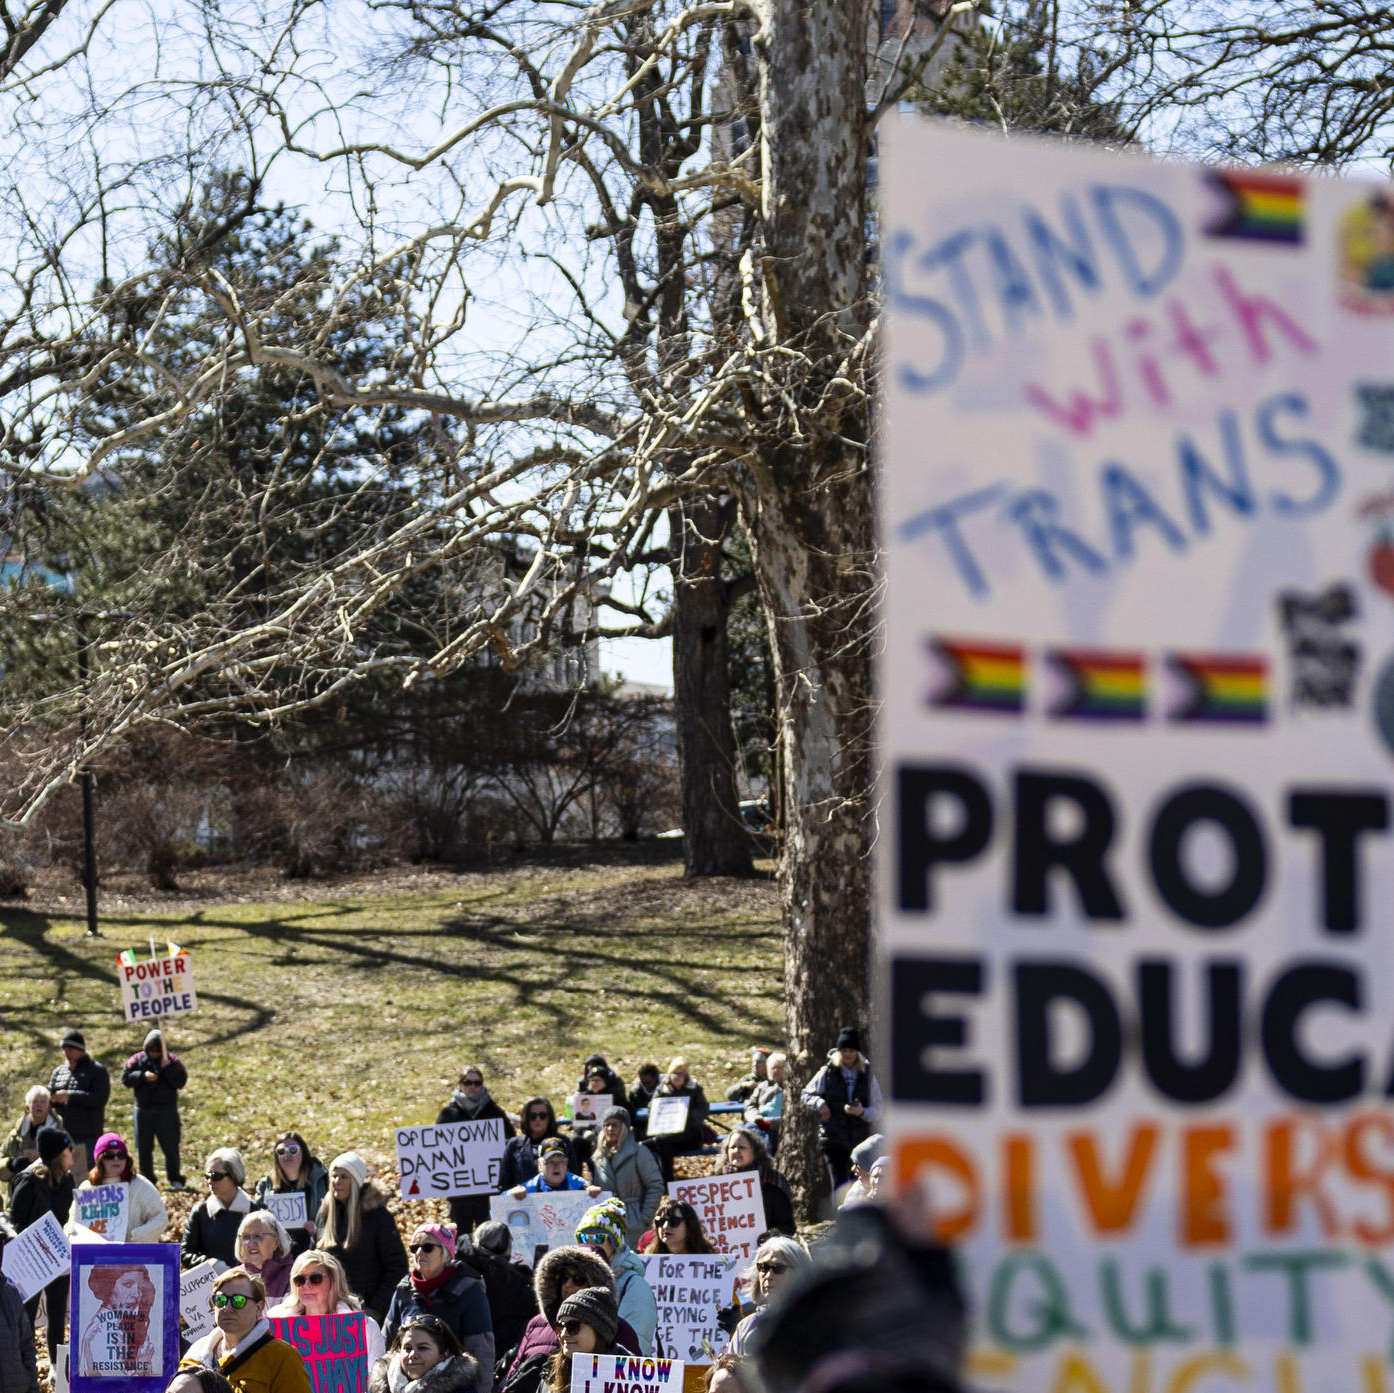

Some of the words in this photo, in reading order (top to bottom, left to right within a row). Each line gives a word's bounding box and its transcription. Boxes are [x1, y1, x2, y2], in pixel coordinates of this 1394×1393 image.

[886, 183, 1187, 396] STAND
[895, 393, 1342, 603] TRANS
[124, 958, 186, 982] POWER
[131, 981, 152, 999] TO
[154, 976, 183, 996] THE
[130, 993, 192, 1018] PEOPLE
[457, 1119, 500, 1143] OWN
[400, 1144, 467, 1177] DAMN
[676, 1178, 756, 1206] RESPECT
[703, 1203, 726, 1218] MY
[689, 1260, 723, 1280] THE
[180, 1271, 215, 1297] SUPPORT
[96, 1311, 146, 1325] WOMAN'S
[106, 1321, 136, 1332] PLACE
[106, 1332, 119, 1345] IS
[122, 1332, 136, 1345] IN
[315, 1311, 366, 1355] JUST
[688, 1327, 724, 1343] THE
[106, 1346, 136, 1360] THE
[92, 1361, 150, 1371] RESISTANCE
[592, 1355, 598, 1378] I
[614, 1356, 673, 1383] KNOW
